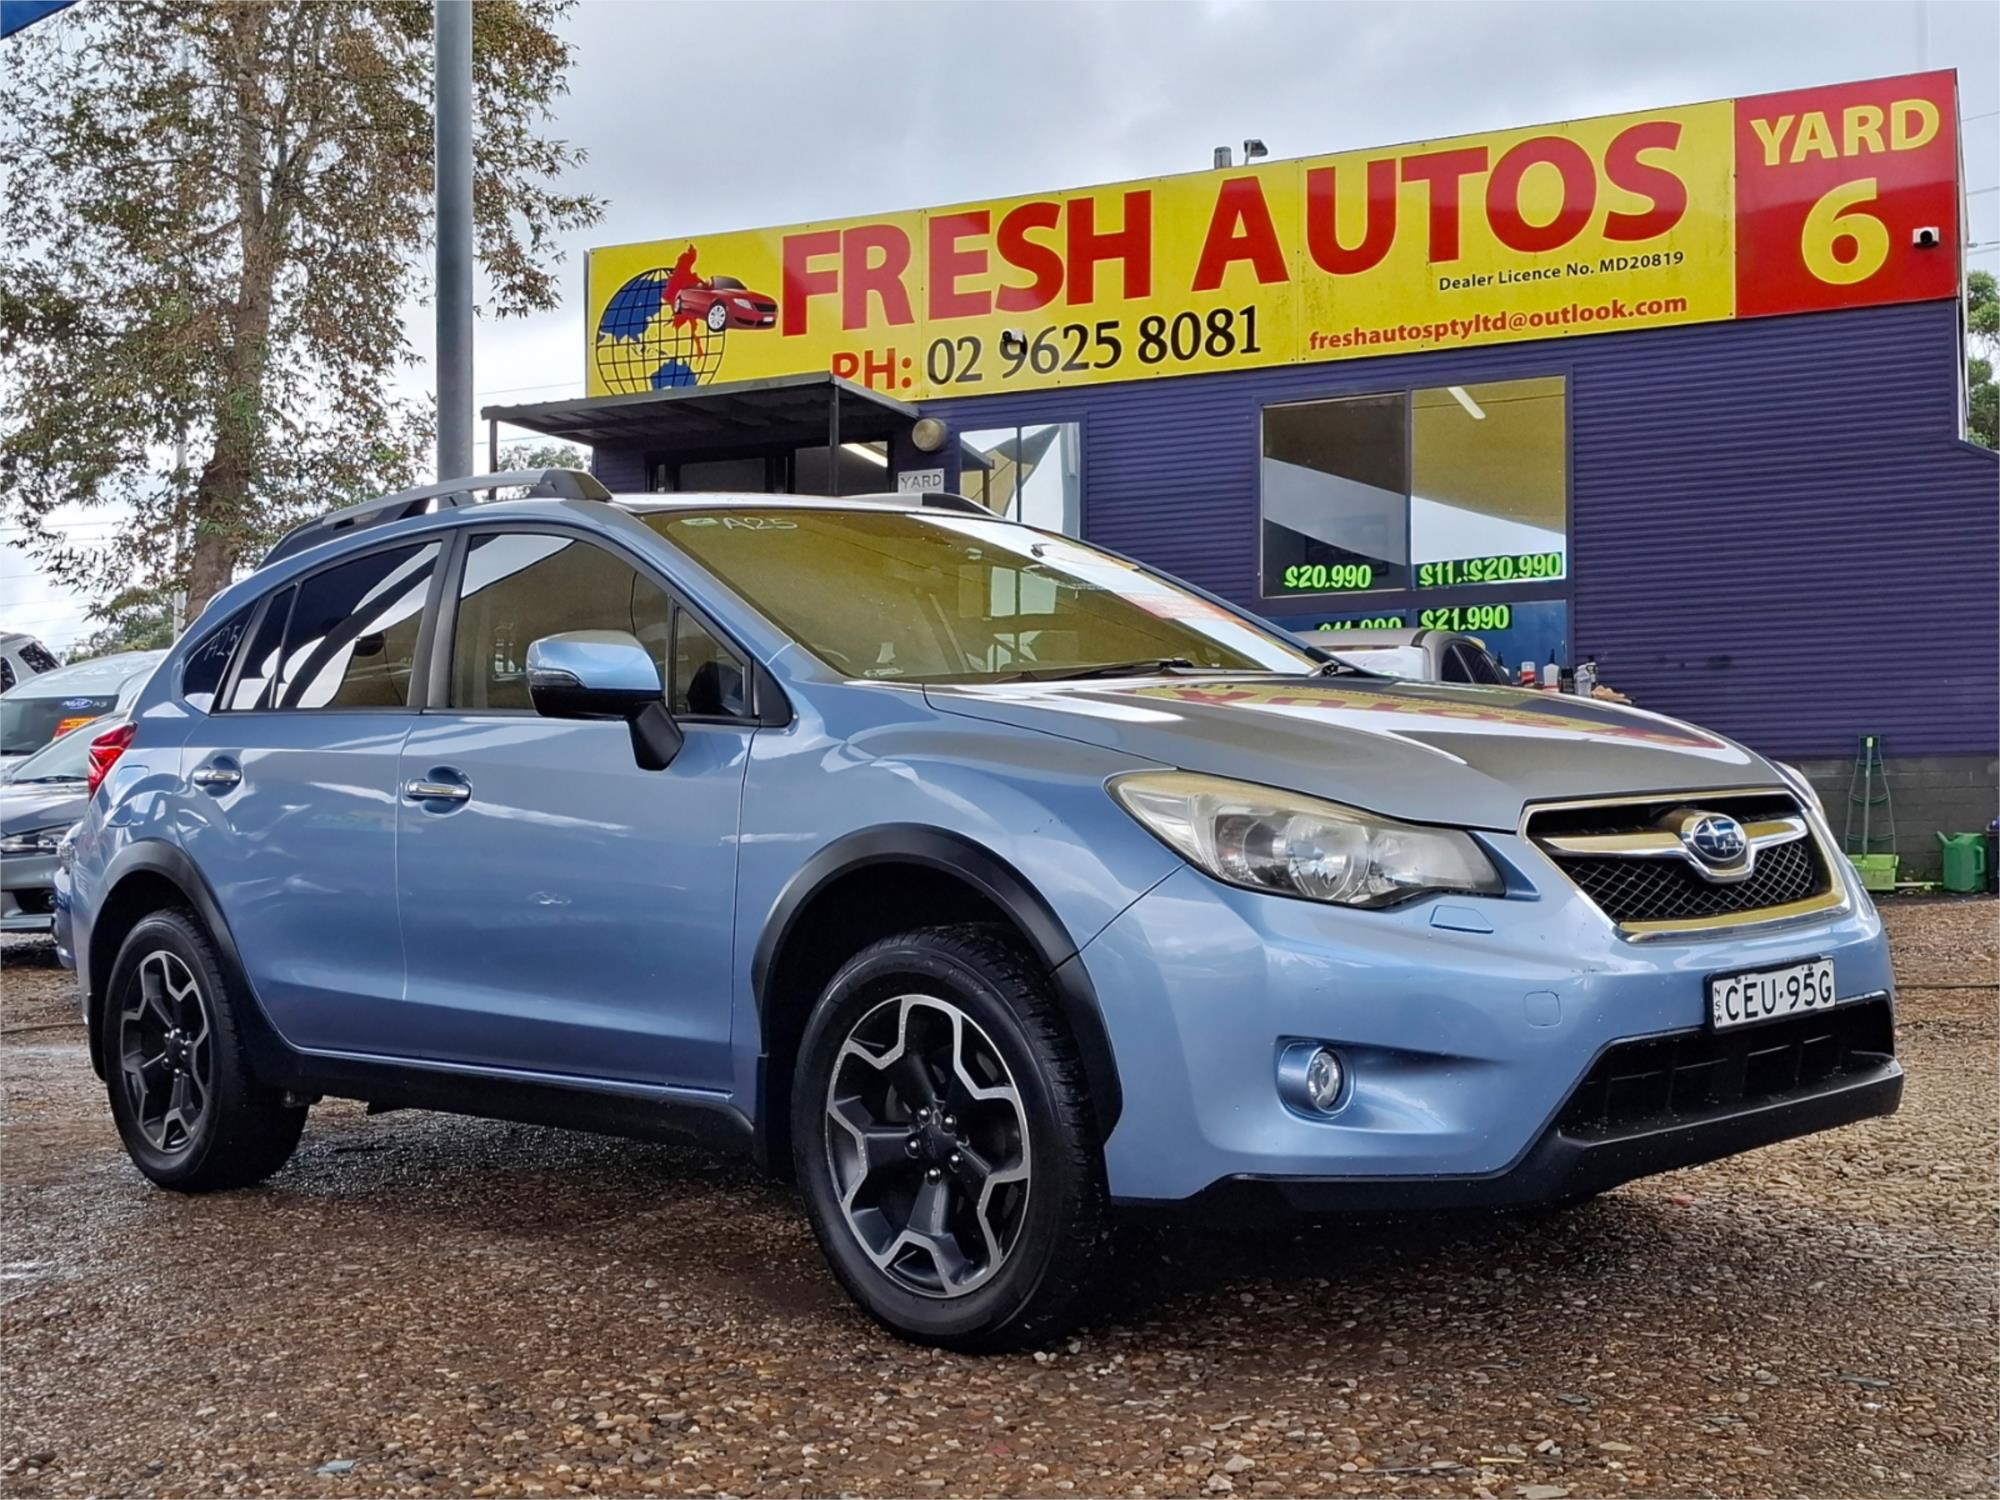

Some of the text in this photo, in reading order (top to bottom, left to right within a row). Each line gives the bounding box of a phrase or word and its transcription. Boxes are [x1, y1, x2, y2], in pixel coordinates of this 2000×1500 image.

[1750, 98, 1940, 166] YARD
[782, 120, 1688, 337] FRESH AUTOS
[1801, 177, 1889, 285] 6
[1439, 251, 1684, 291] Dealer Licence No. MD20819
[832, 305, 1261, 390] PH: 02 9625 8081
[1309, 296, 1687, 350] freshautosptyltd@outlook.com
[900, 473, 942, 489] YARD
[722, 516, 799, 530] A25
